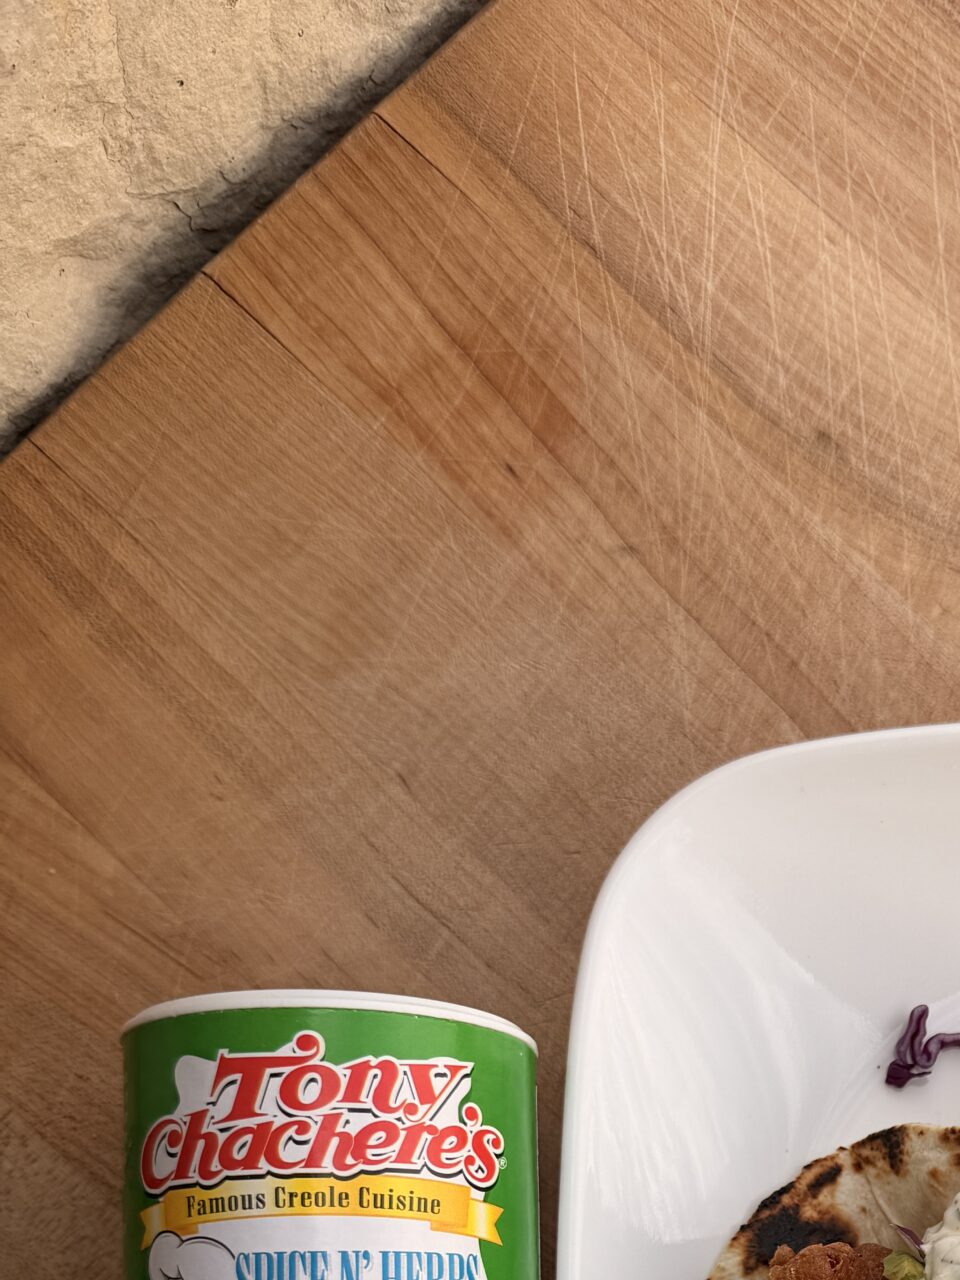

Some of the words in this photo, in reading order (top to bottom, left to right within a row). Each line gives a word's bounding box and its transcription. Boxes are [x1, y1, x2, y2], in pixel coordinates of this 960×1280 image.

[210, 1033, 470, 1124] Tony
[141, 1106, 502, 1190] Chachere's
[186, 1189, 266, 1218] Famous
[274, 1186, 350, 1209] Creole
[358, 1187, 442, 1215] Cuisine
